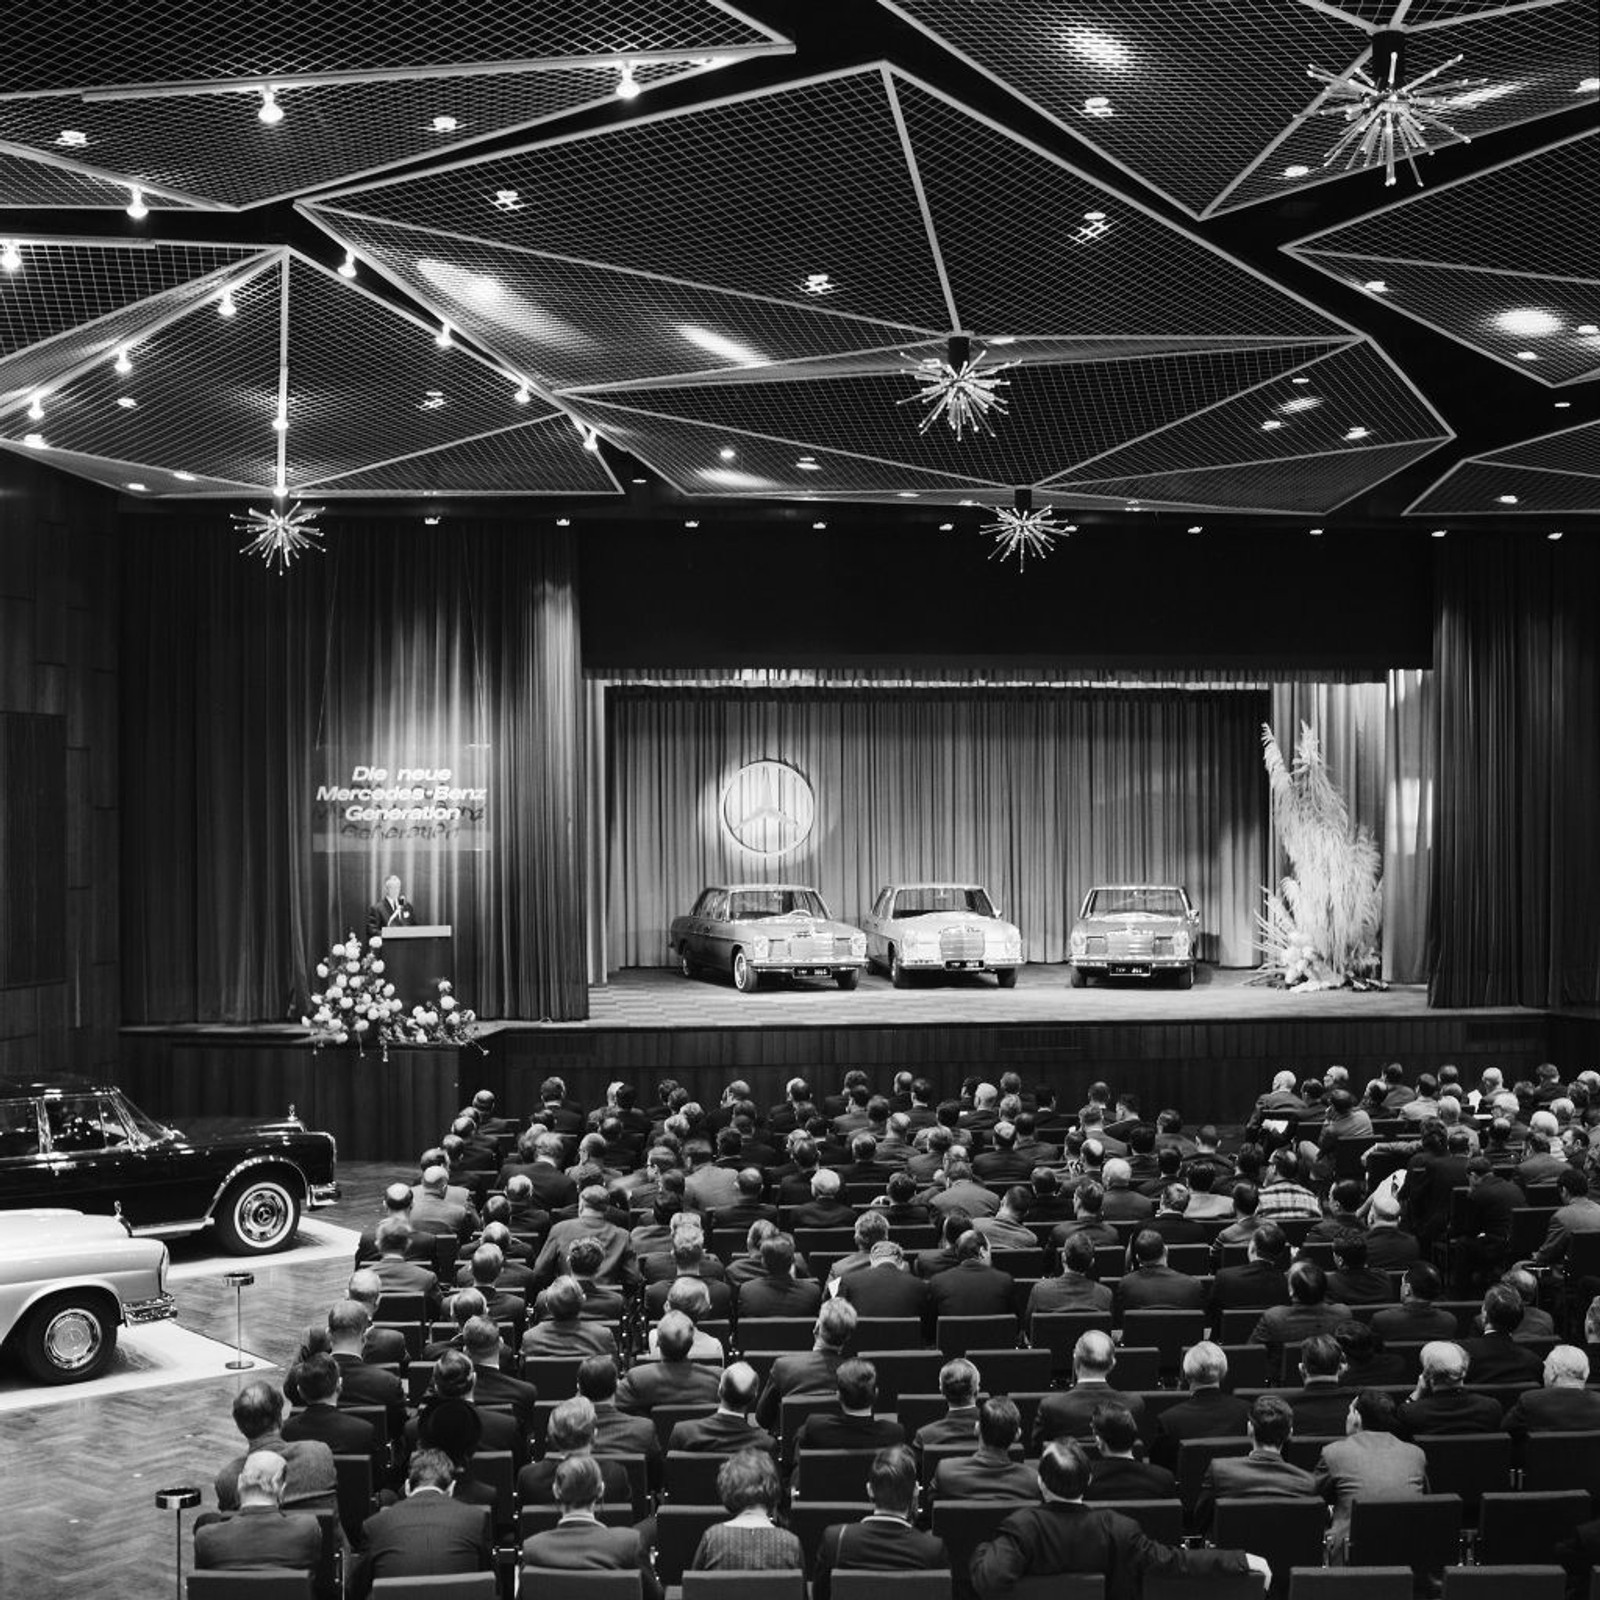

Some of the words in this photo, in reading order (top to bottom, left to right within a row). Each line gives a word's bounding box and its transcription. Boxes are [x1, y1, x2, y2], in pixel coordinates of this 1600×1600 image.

[352, 766, 388, 781] Die
[397, 768, 451, 781] neue
[345, 805, 460, 821] Generation
